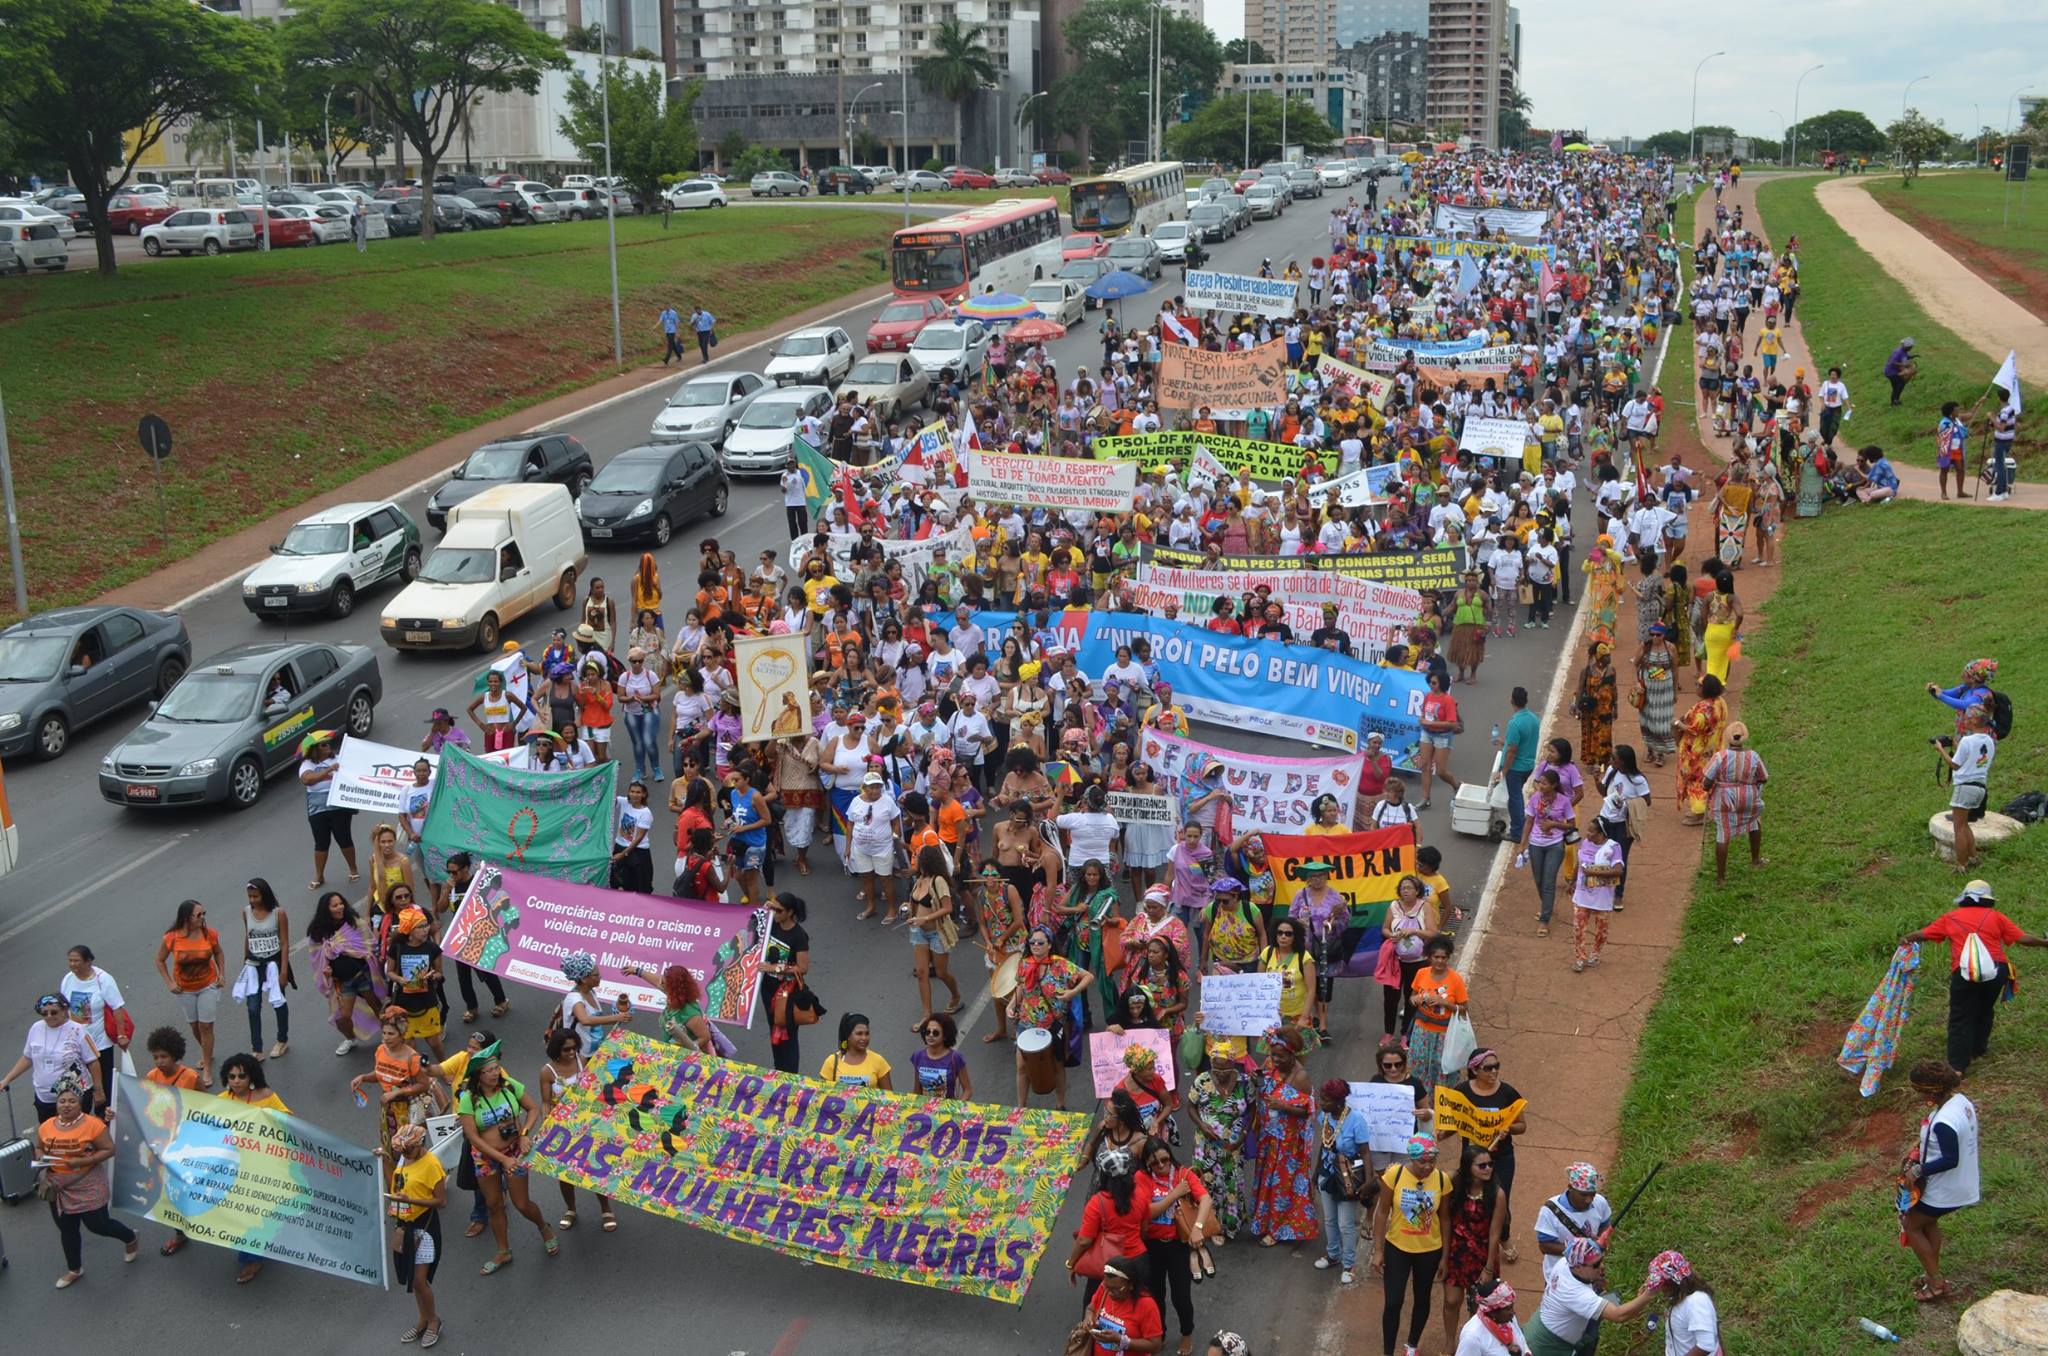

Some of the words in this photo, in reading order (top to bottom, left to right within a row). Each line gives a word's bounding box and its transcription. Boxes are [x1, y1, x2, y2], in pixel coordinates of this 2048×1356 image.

[1436, 241, 1451, 256] DE
[1187, 271, 1212, 290] Igreja
[1214, 273, 1268, 295] Presbiteriana
[1099, 439, 1108, 448] O
[1182, 434, 1241, 449] MARCHA
[1246, 442, 1269, 452] AO
[1117, 446, 1192, 458] MULHERES
[1259, 455, 1281, 466] NA
[991, 468, 1006, 480] LEI
[1011, 470, 1023, 481] DE
[1029, 471, 1106, 487] TOMBAMENTO
[1066, 463, 1116, 476] RESPEITA
[970, 479, 998, 488] CULTURAL
[1028, 494, 1041, 503] DA
[1045, 496, 1079, 506] ALDEIA
[1230, 558, 1248, 569] DA
[1250, 559, 1275, 570] PEC
[1277, 557, 1300, 569] 215
[1422, 551, 1456, 563] SERÁ
[1150, 567, 1166, 586] As
[1169, 568, 1224, 590] Mulheres
[1228, 575, 1240, 590] se
[1284, 573, 1316, 593] conta
[1319, 574, 1331, 594] de
[1334, 576, 1367, 601] tanta
[1386, 568, 1405, 578] DO
[1200, 644, 1260, 679] PELO
[1267, 656, 1318, 690] BEM
[339, 784, 382, 797] Movimento
[382, 792, 396, 801] por
[1284, 773, 1320, 797] DE
[340, 795, 371, 805] Construir
[1364, 848, 1401, 877] RN
[526, 895, 605, 922] Comerciárias
[608, 912, 645, 929] contra
[647, 919, 655, 929] o
[657, 920, 702, 936] racismo
[704, 927, 711, 937] e
[713, 927, 721, 938] a
[543, 917, 598, 939] violência
[600, 930, 608, 940] e
[610, 929, 636, 944] pelo
[638, 932, 663, 948] bem
[665, 937, 695, 953] viver.
[518, 934, 568, 959] Marcha
[600, 951, 658, 975] Mulheres
[510, 965, 538, 980] Sindicato
[638, 993, 653, 1004] CUT
[668, 1062, 877, 1143] PARAIBA
[186, 1109, 254, 1134] IGUALDADE
[259, 1125, 299, 1147] RACIAL
[301, 1139, 316, 1153] NA
[318, 1147, 374, 1177] EDUCAÇÃO
[222, 1135, 261, 1152] NOSSA
[899, 1113, 1013, 1165] 2015
[229, 1168, 238, 1178] DA
[240, 1171, 249, 1181] LEI
[251, 1172, 281, 1188] 10.639/03
[282, 1181, 291, 1190] DO
[292, 1183, 312, 1197] ENSINO
[712, 1134, 901, 1207] MARCHA
[193, 1175, 204, 1186] POR
[206, 1179, 245, 1197] REPARAÇÕES
[322, 1209, 329, 1217] DE
[537, 1125, 623, 1177] DAS
[631, 1160, 854, 1254] MULHERES
[861, 1221, 1032, 1282] NEGRAS
[203, 1194, 233, 1209] PUNIÇÕES
[233, 1202, 244, 1211] AO
[245, 1203, 260, 1216] NÃO
[260, 1208, 305, 1227] CUMPRIMENTO
[305, 1219, 314, 1228] DA
[314, 1222, 324, 1232] LEI
[219, 1230, 247, 1246] Grupo
[250, 1239, 261, 1249] de
[264, 1242, 305, 1260] Mulheres
[308, 1253, 337, 1268] Negras
[340, 1260, 352, 1271] do
[354, 1264, 377, 1279] Cariri
